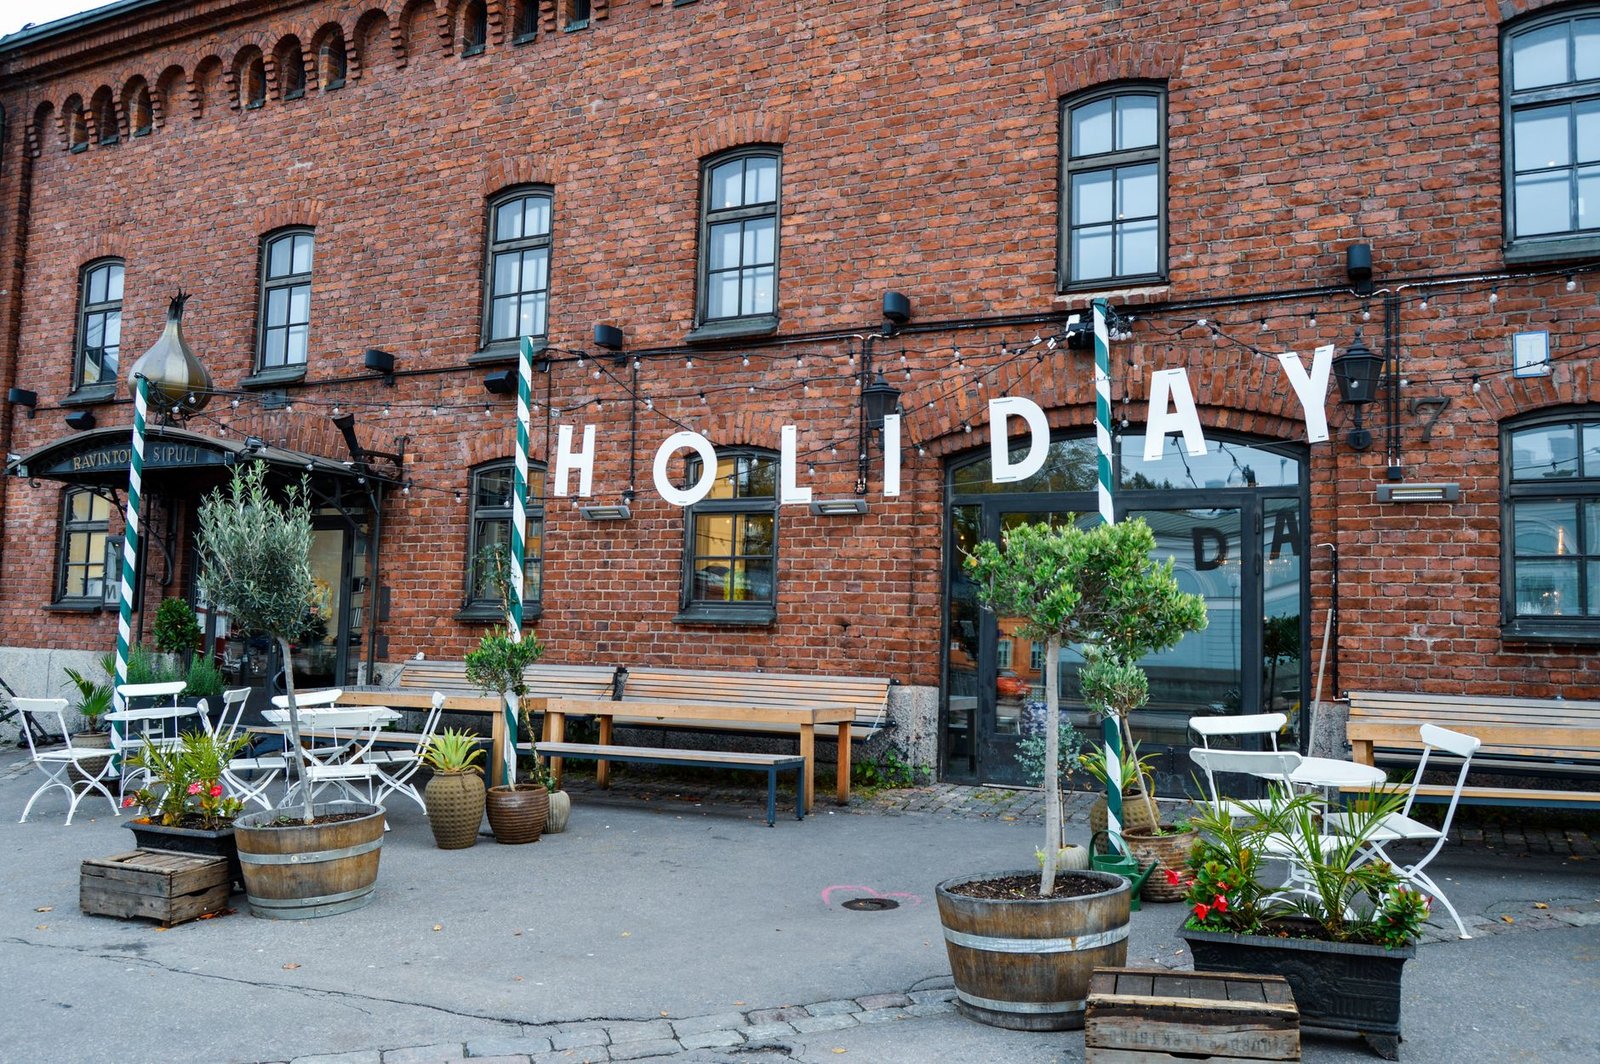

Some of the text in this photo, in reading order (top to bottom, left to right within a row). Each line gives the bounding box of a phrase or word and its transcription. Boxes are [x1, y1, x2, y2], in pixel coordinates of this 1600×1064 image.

[554, 344, 1335, 506] HOLIDAY
[1411, 396, 1450, 443] 7
[73, 446, 199, 471] RAVINTO SIPULI
